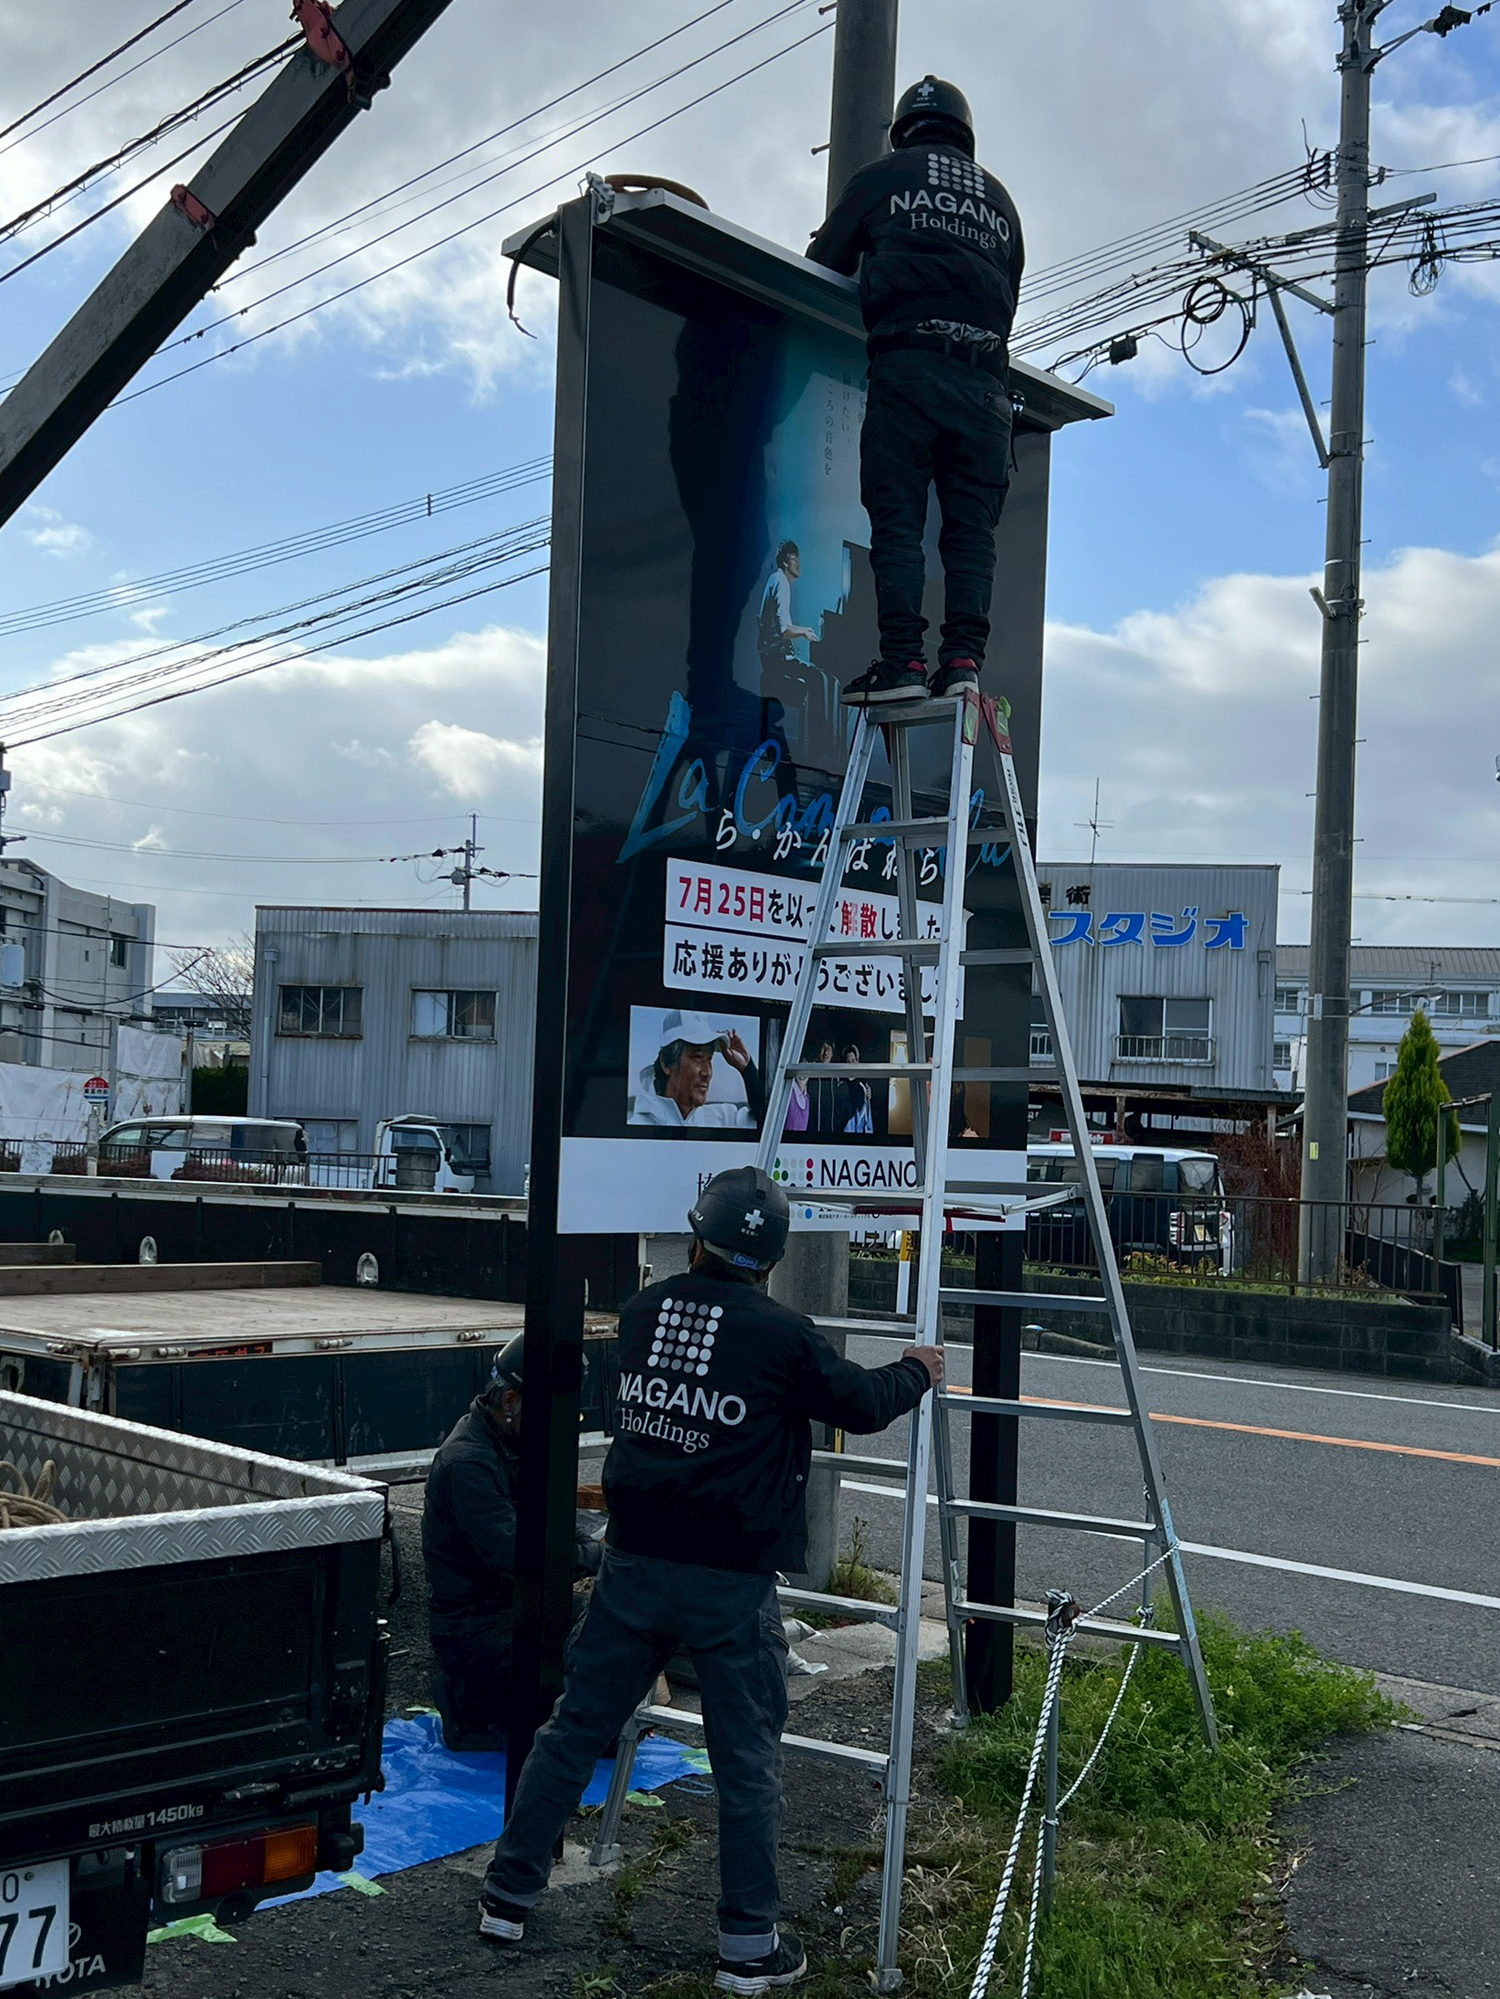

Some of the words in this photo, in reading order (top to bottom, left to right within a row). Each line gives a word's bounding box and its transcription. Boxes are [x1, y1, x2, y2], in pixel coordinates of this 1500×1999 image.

[890, 188, 1009, 242] NAGANO
[910, 212, 997, 249] Holdings
[615, 690, 721, 865] La
[1048, 906, 1250, 949] スタジオ
[820, 1158, 918, 1188] NAGANO
[617, 1372, 747, 1426] NAGANO
[620, 1407, 710, 1453] Holdings
